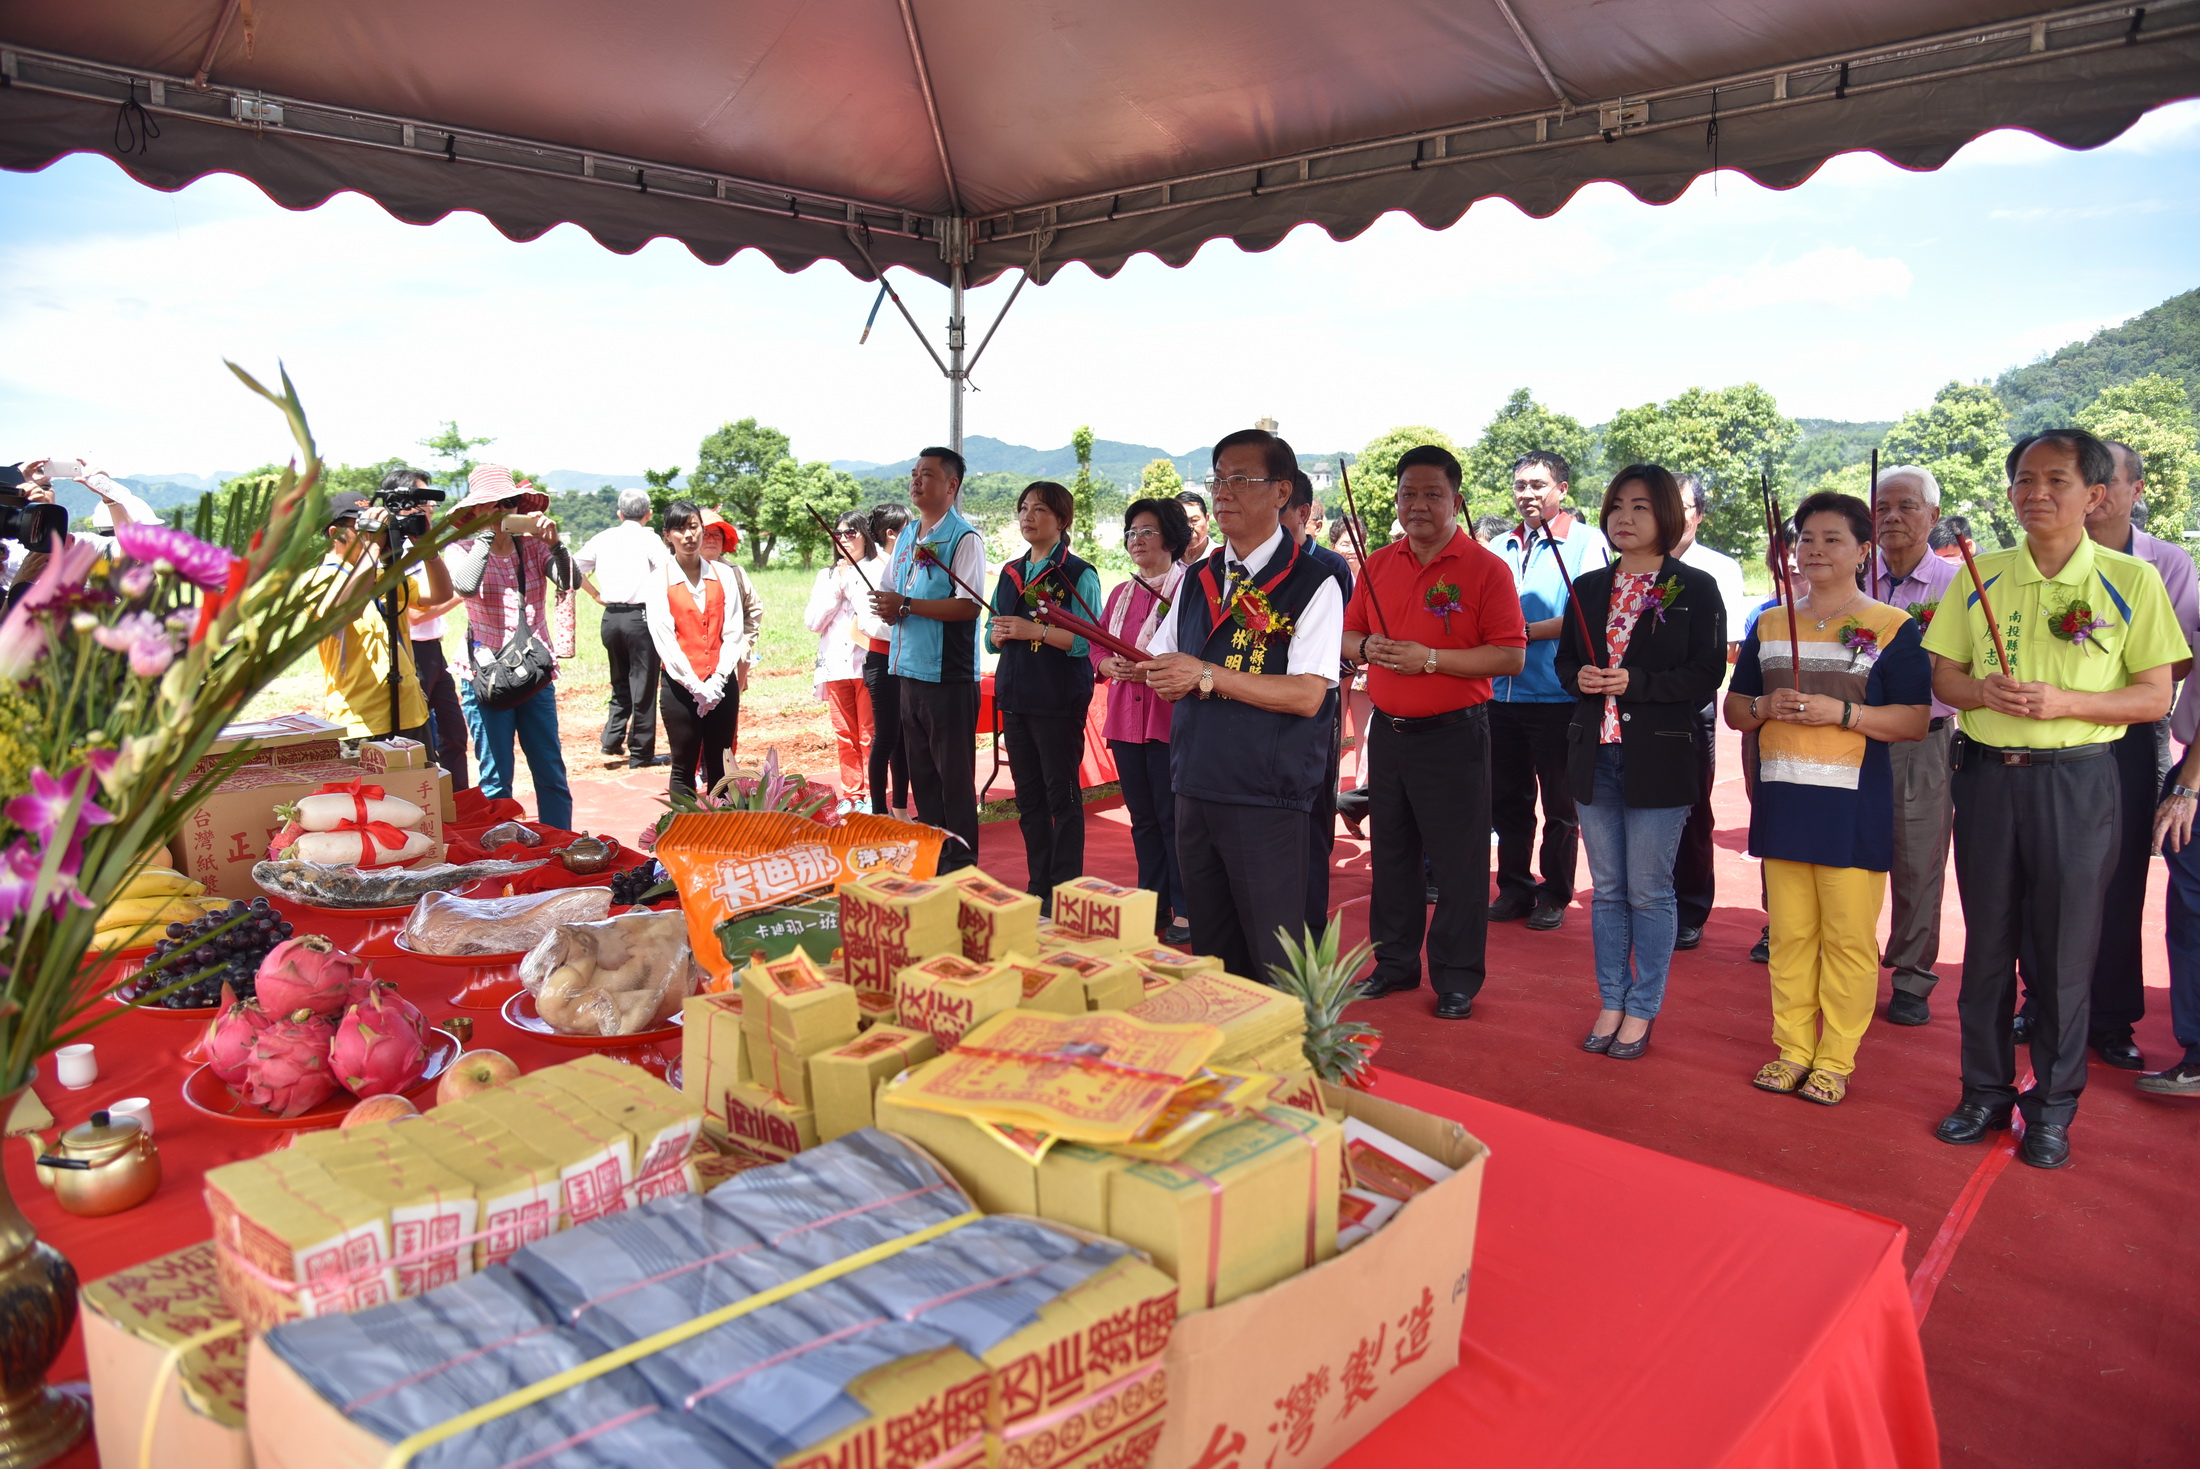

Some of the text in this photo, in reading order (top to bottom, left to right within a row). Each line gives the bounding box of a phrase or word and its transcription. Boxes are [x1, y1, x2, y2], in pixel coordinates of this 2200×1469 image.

[193, 808, 220, 896] 台灣紙漿
[416, 781, 439, 859] 手工製造
[714, 847, 838, 909] 卡迪那
[755, 913, 838, 939] 卡迪那一班
[1186, 1286, 1434, 1469] 台灣製造
